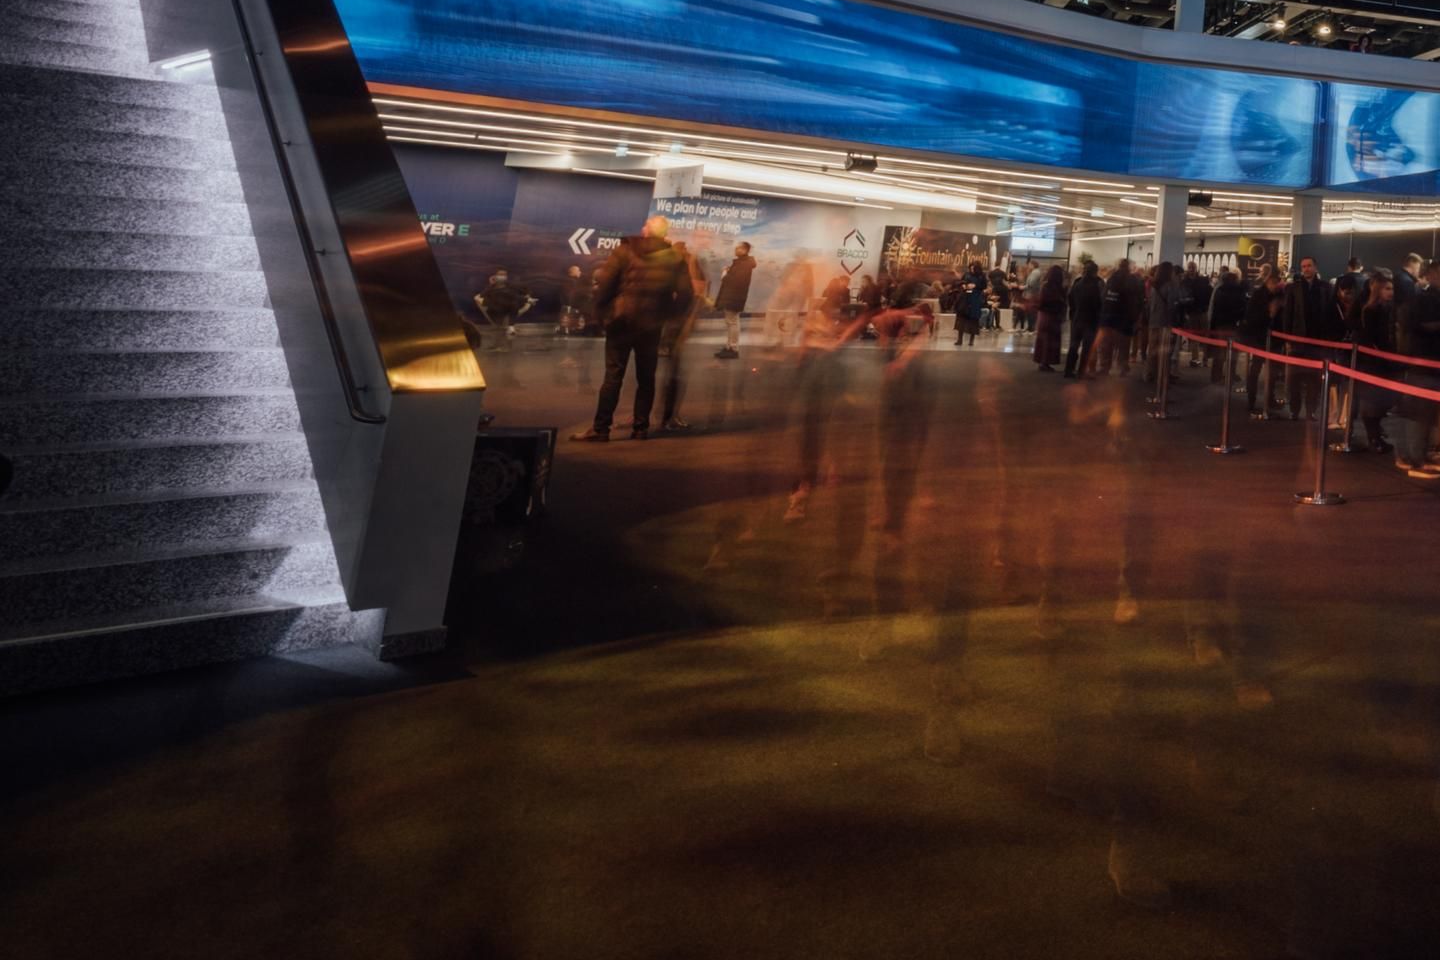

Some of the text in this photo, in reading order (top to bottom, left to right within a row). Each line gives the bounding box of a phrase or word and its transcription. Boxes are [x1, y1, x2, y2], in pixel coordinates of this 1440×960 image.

[656, 199, 758, 220] We plan for people and
[420, 221, 471, 237] YER E
[686, 219, 696, 230] at
[697, 221, 722, 234] every
[723, 221, 741, 235] step
[837, 248, 869, 259] BRACCO
[915, 246, 989, 267] Fountain of Youth
